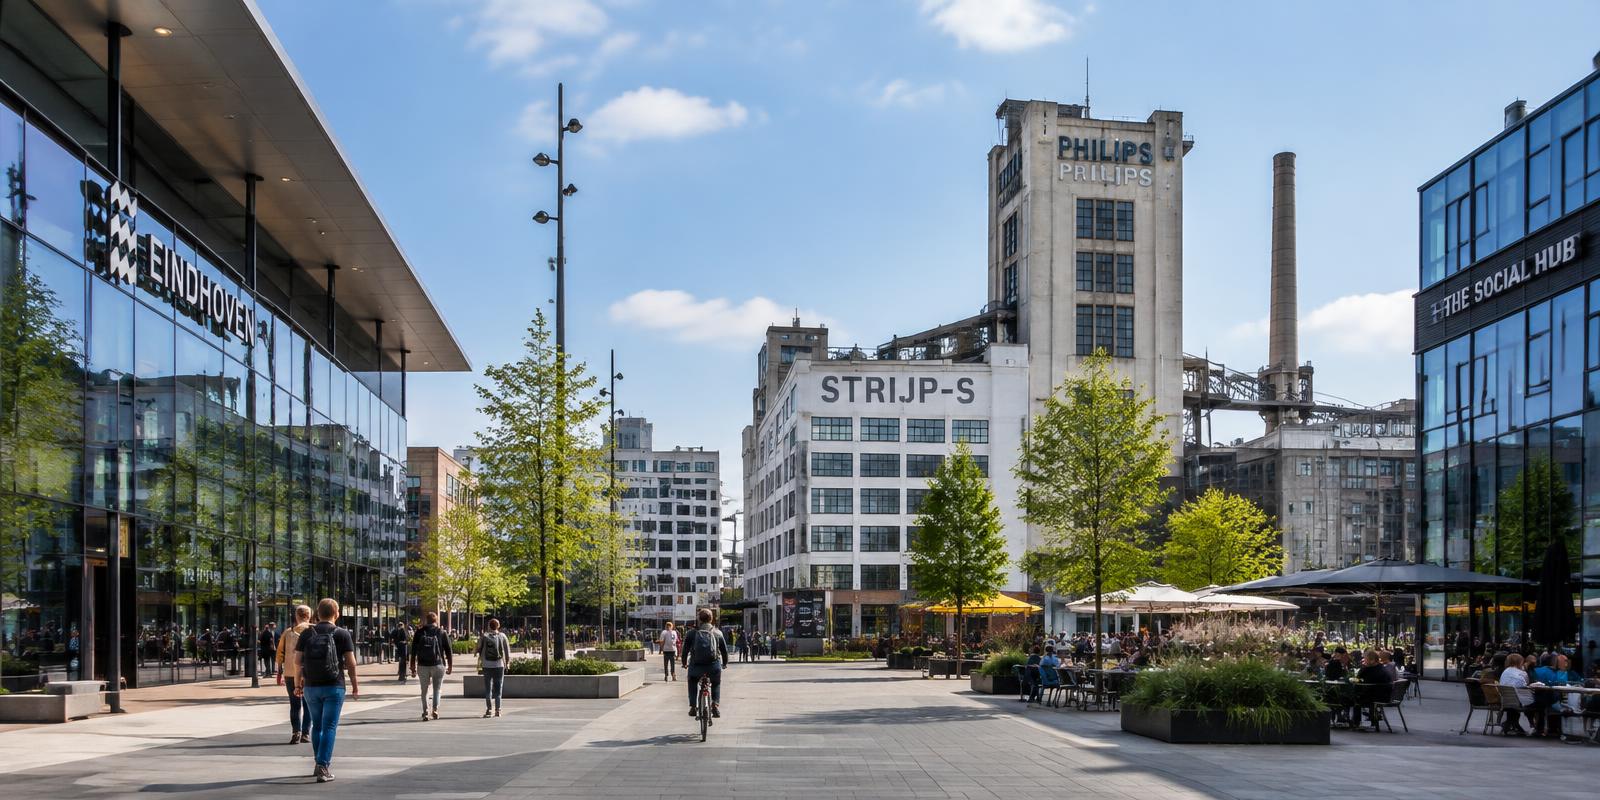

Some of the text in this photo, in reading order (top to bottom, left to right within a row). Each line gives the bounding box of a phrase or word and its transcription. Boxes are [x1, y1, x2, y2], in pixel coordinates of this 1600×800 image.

[1058, 135, 1153, 165] PHILIPS
[150, 233, 256, 348] EINDHOVEN
[1443, 286, 1470, 317] THE
[1475, 259, 1531, 303] SOCIAL
[821, 375, 975, 404] STRIJP-S
